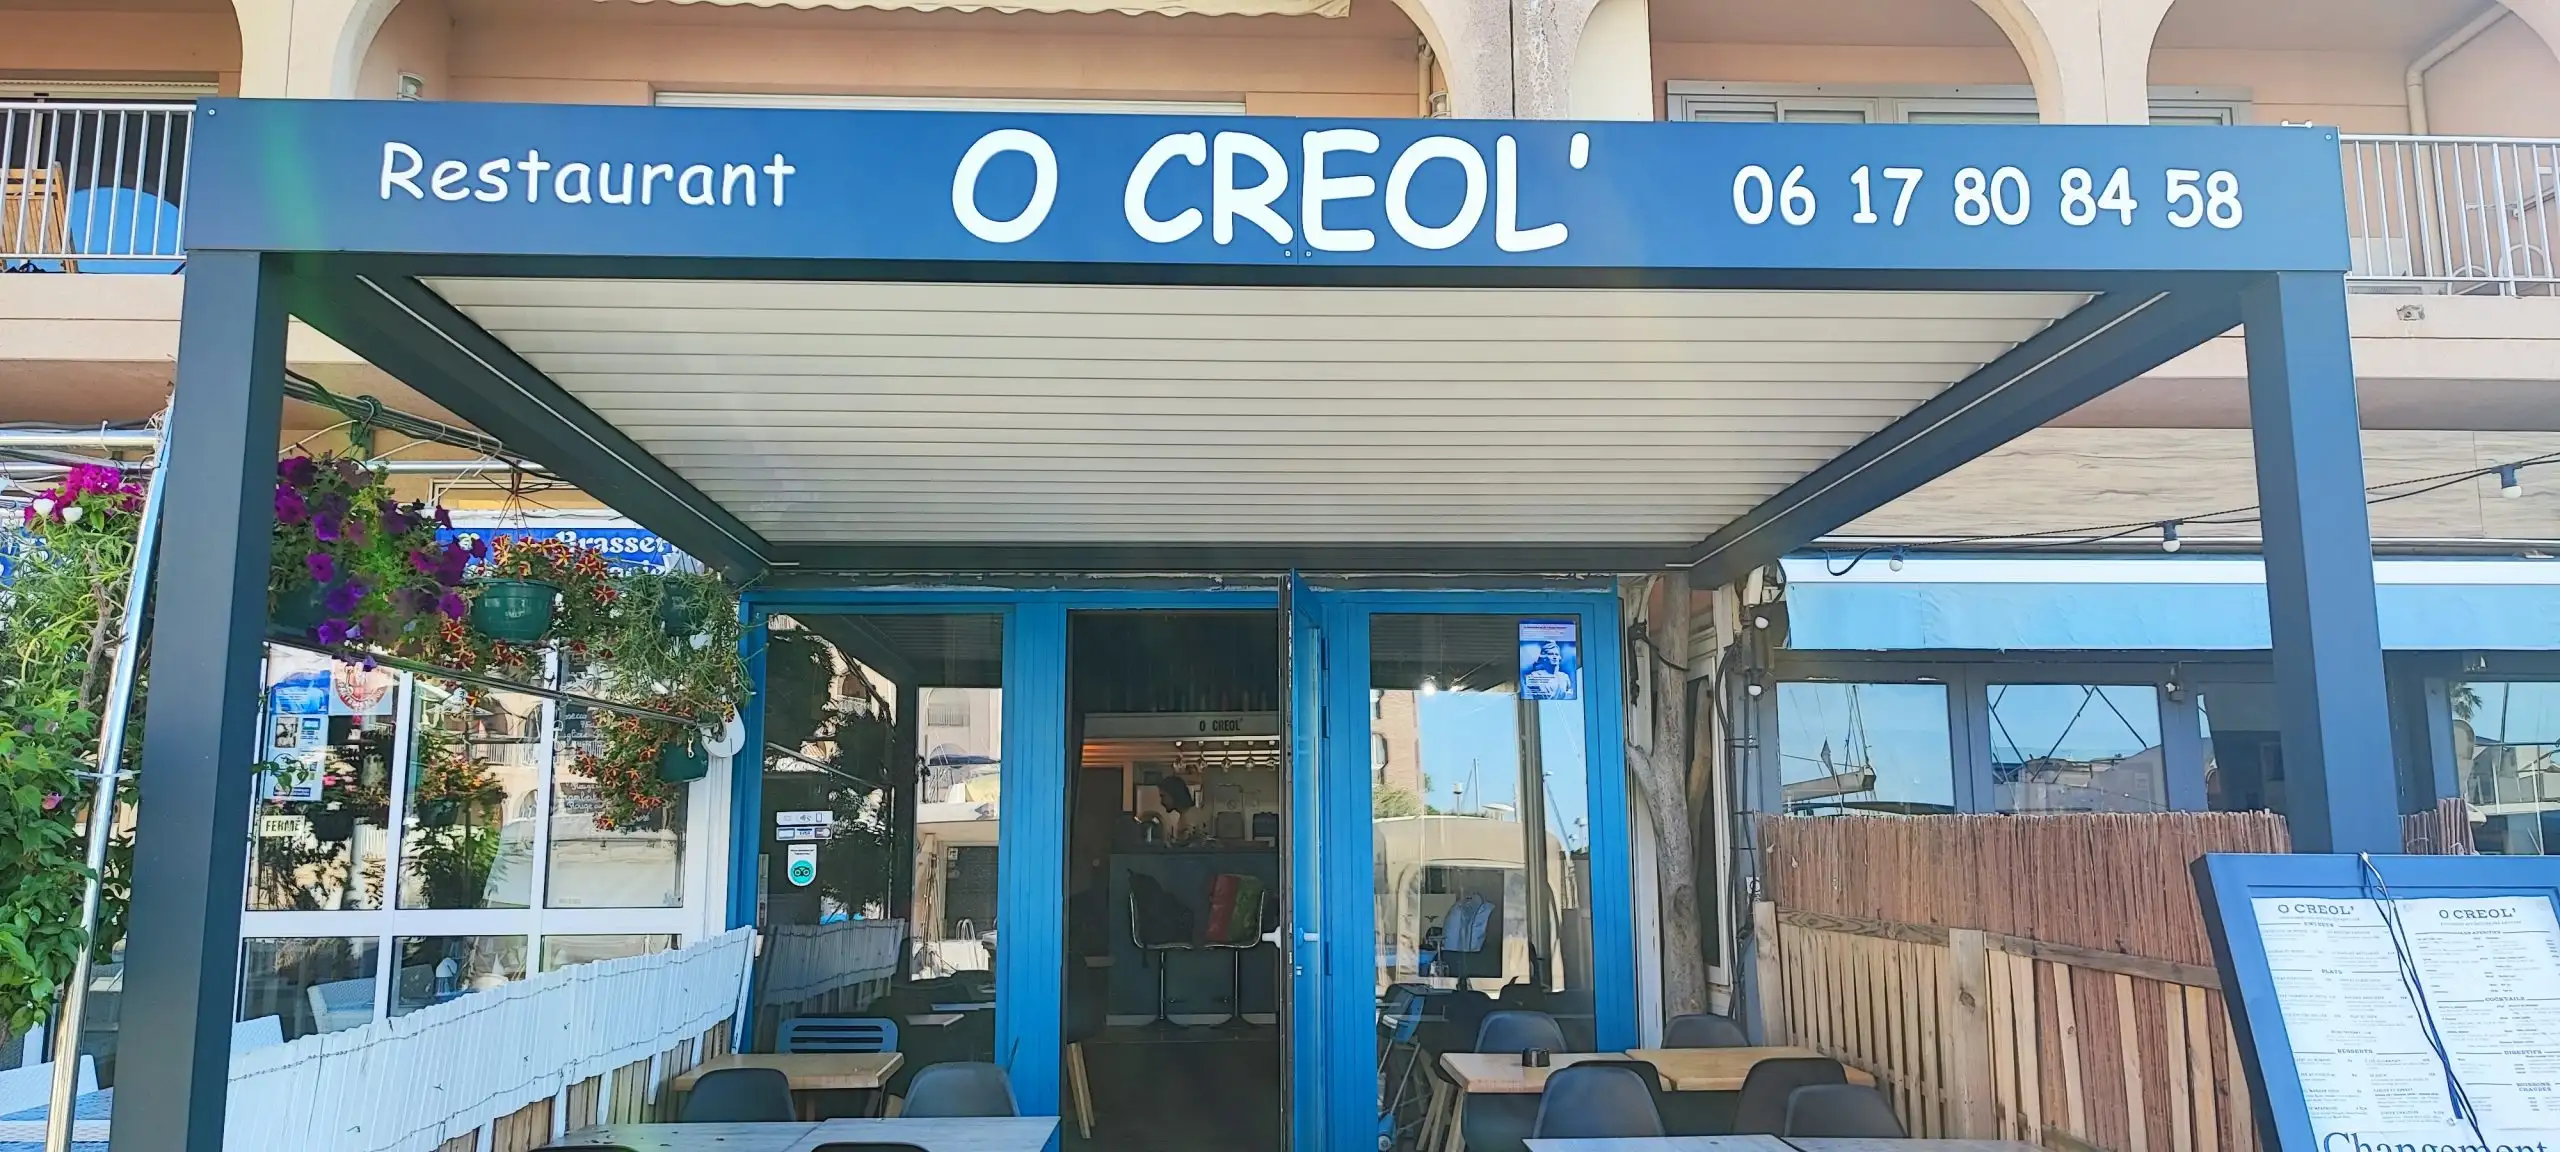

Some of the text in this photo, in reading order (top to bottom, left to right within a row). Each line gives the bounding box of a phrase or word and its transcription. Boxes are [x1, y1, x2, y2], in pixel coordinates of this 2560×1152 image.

[379, 141, 797, 208] Restaurant
[951, 128, 1590, 253] O CREOL'
[1732, 165, 2244, 230] 06 17 80 84 58
[555, 530, 679, 554] Brasser
[1199, 719, 1206, 732] O
[2277, 903, 2354, 915] O CREOL'
[2438, 907, 2516, 919] O CREOL'
